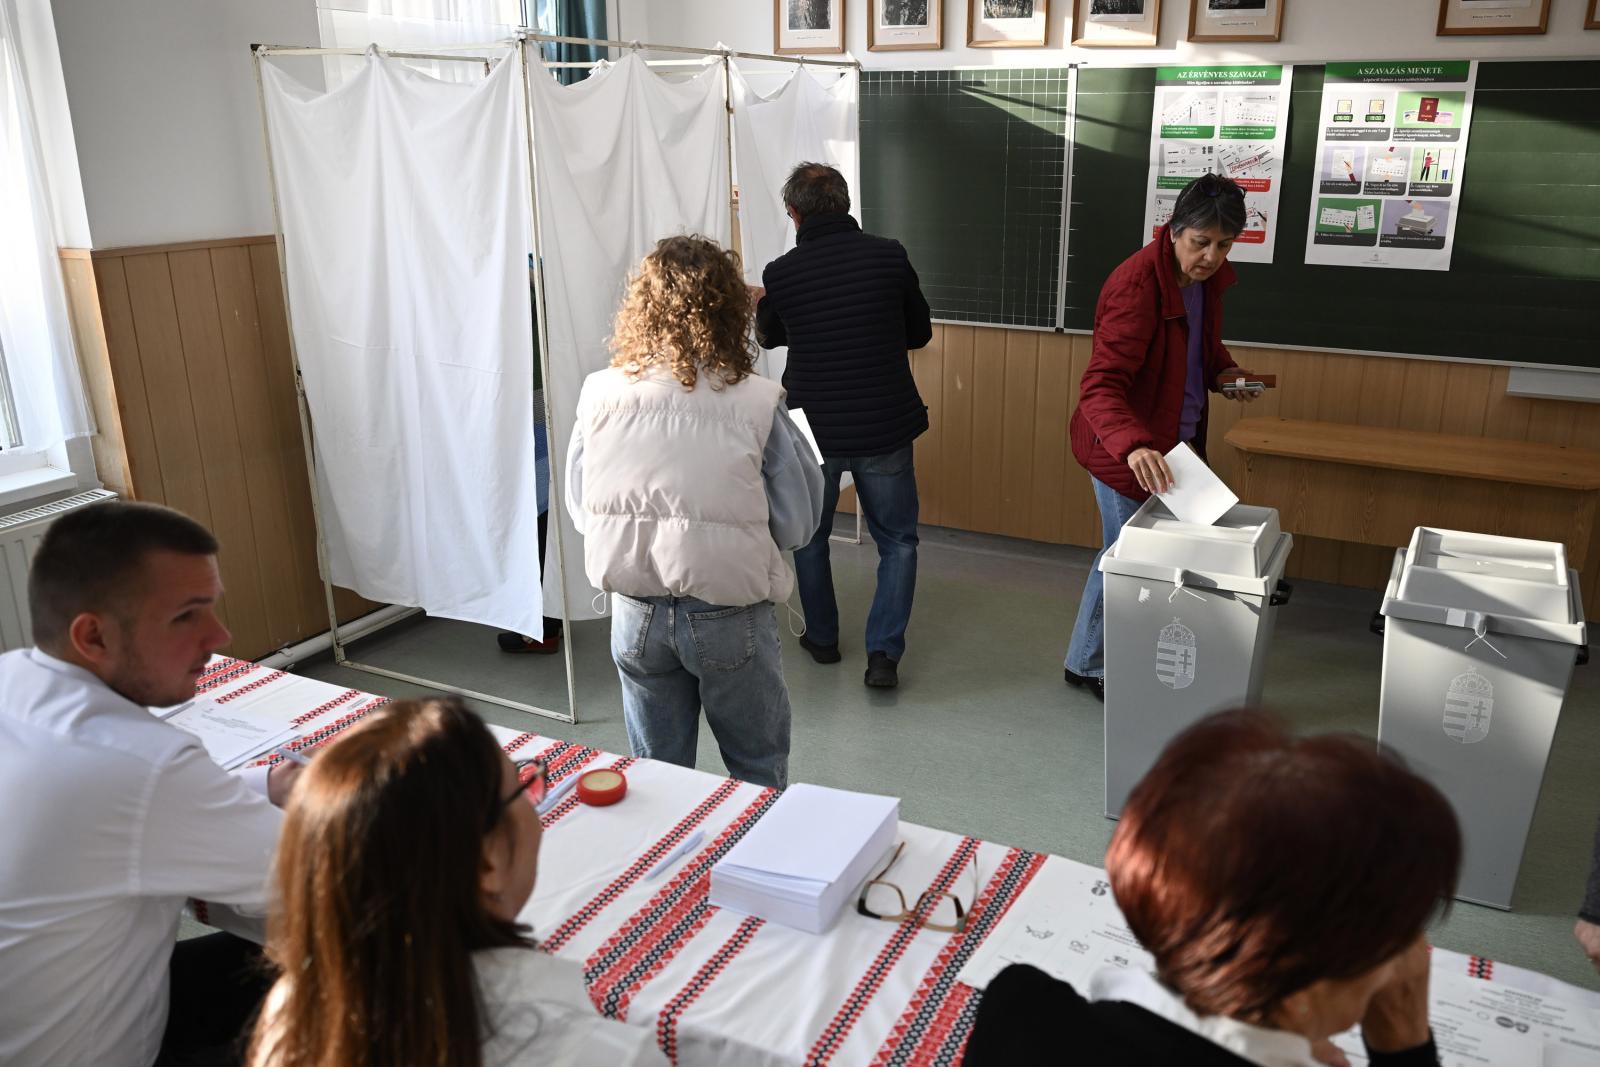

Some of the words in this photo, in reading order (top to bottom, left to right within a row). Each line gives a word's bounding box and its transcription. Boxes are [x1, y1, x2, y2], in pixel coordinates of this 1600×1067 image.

[1177, 71, 1188, 79] AZ
[1188, 70, 1228, 78] ÉRVÉNYES
[1229, 70, 1267, 78] SZAVAZAT
[1364, 66, 1406, 75] SZAVAZÁS
[1407, 66, 1444, 74] MENETE
